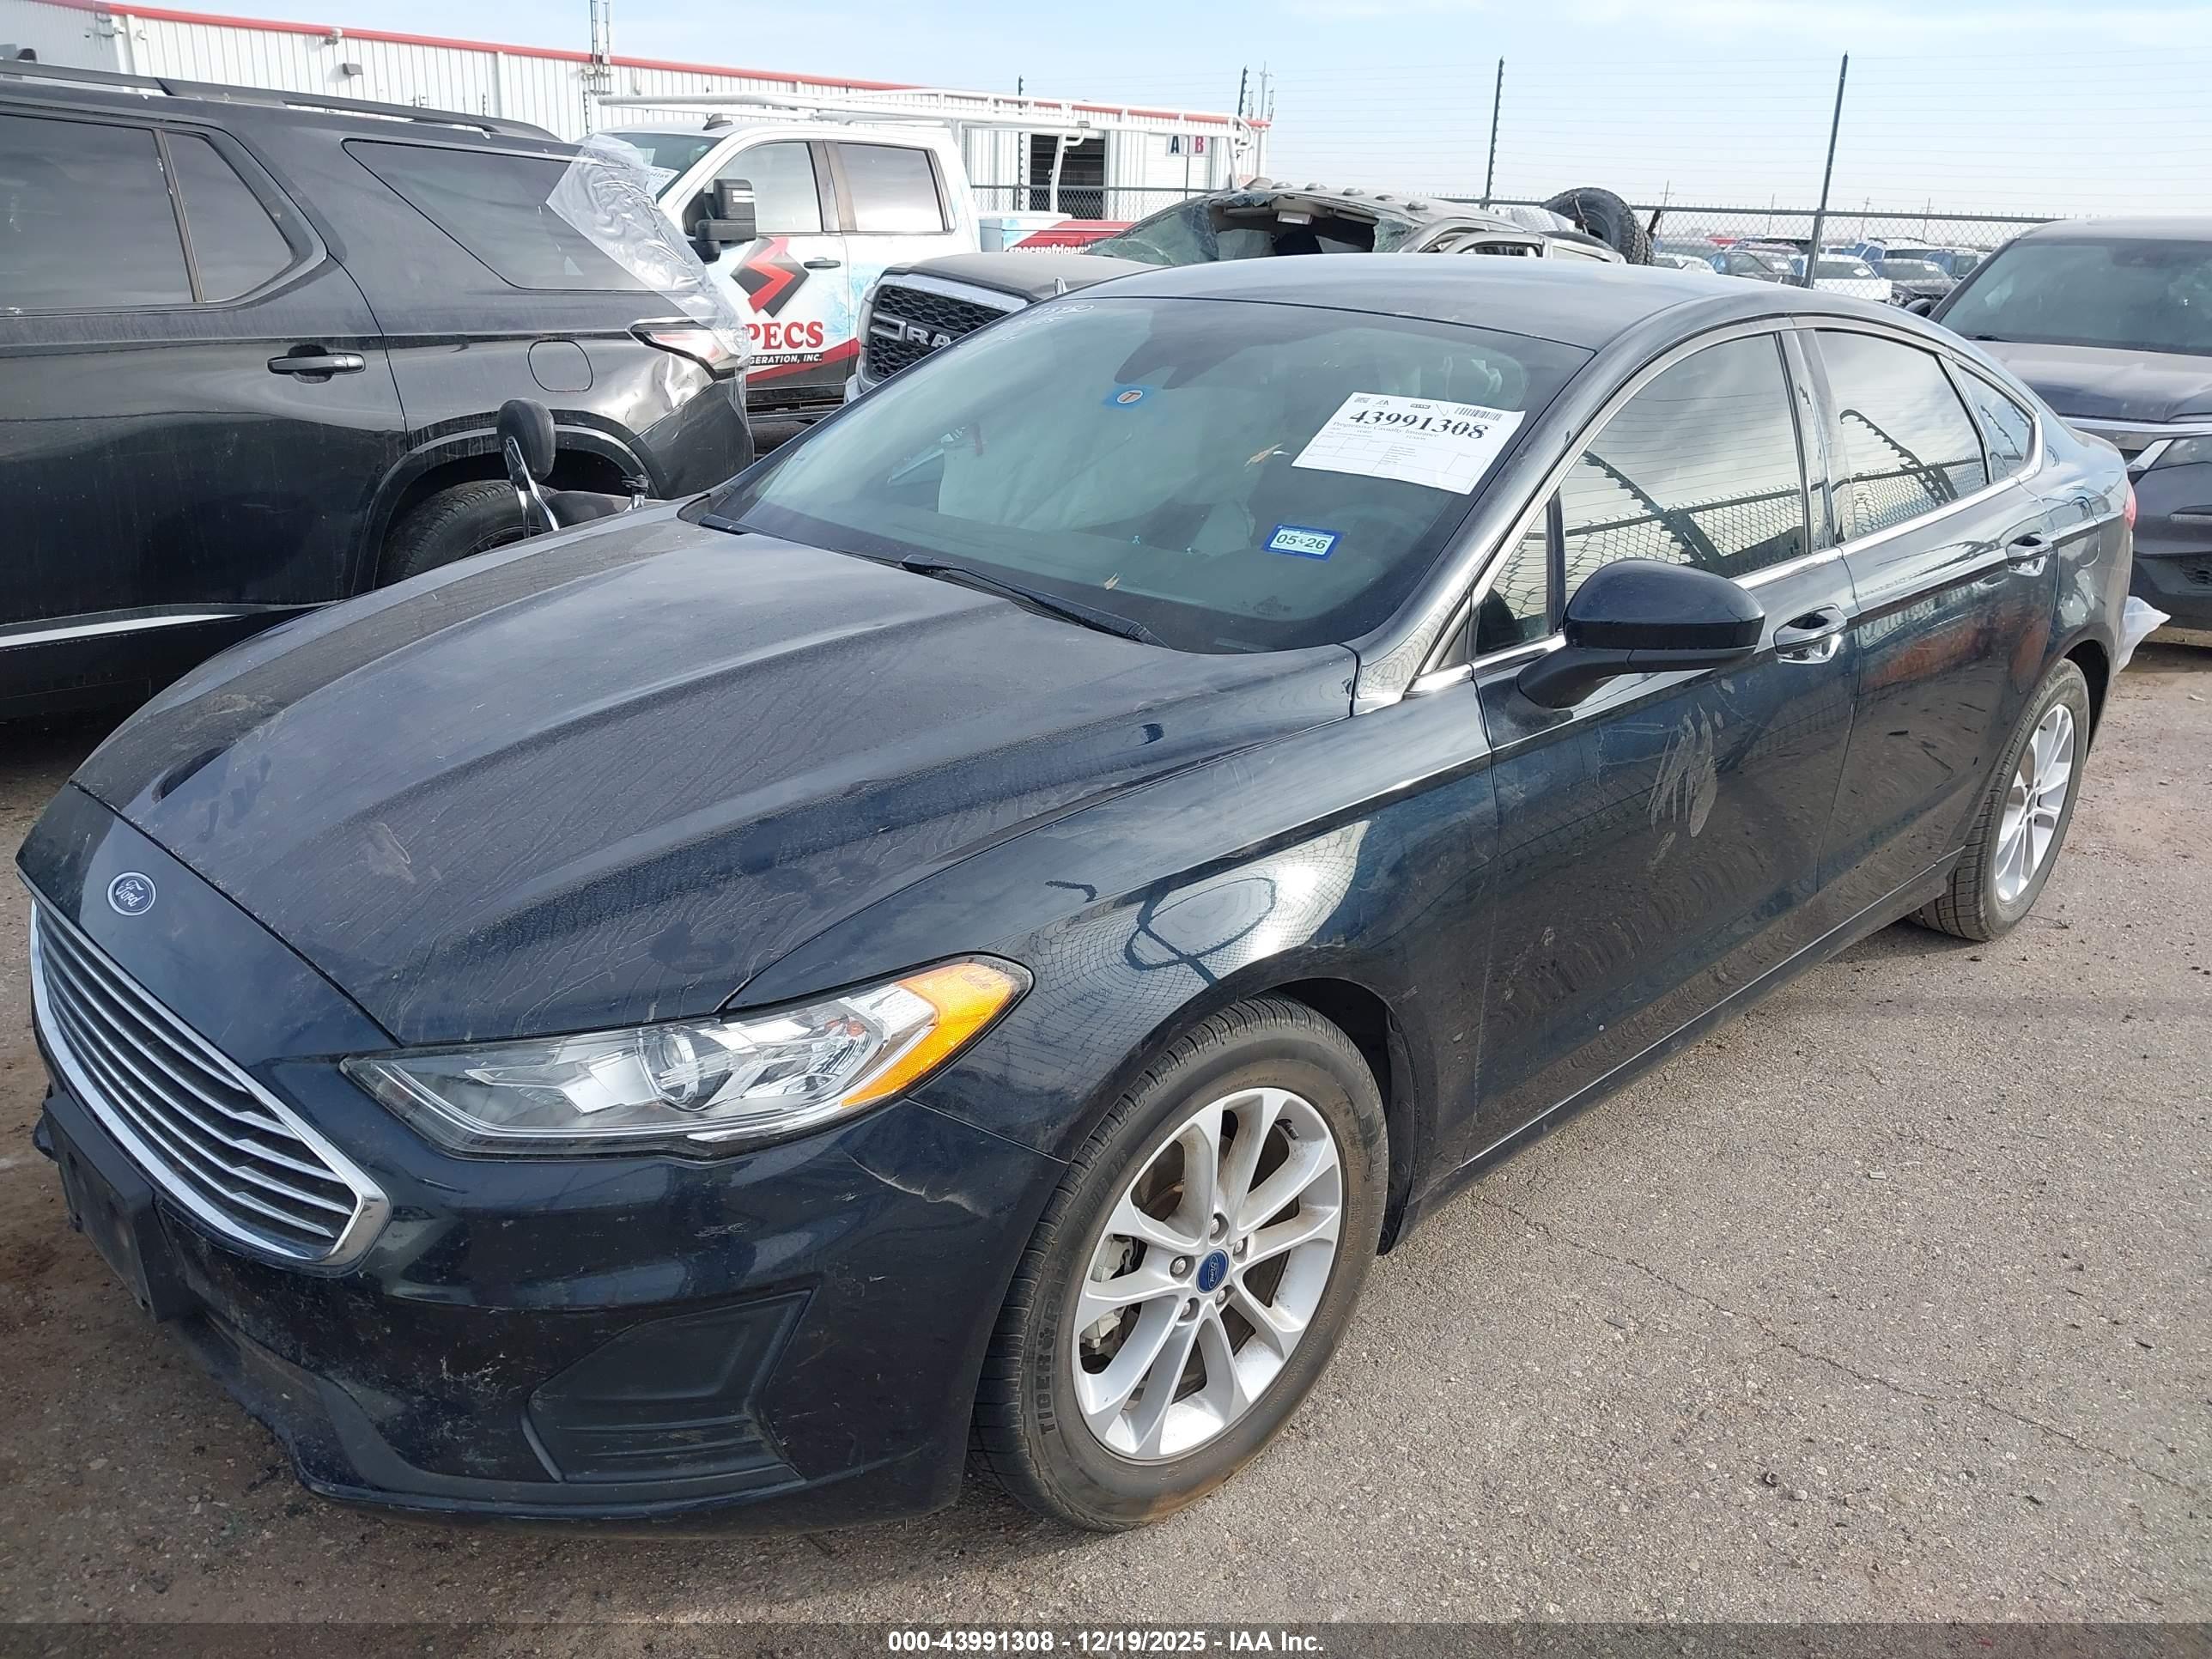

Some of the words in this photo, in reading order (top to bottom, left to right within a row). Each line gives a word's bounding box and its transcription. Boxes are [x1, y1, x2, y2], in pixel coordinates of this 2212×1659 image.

[1170, 136, 1179, 154] A
[1194, 136, 1204, 154] B
[803, 353, 823, 362] INC.
[1349, 410, 1488, 439] 43991308
[115, 878, 145, 908] Ford
[1036, 1353, 1057, 1437] TIGER
